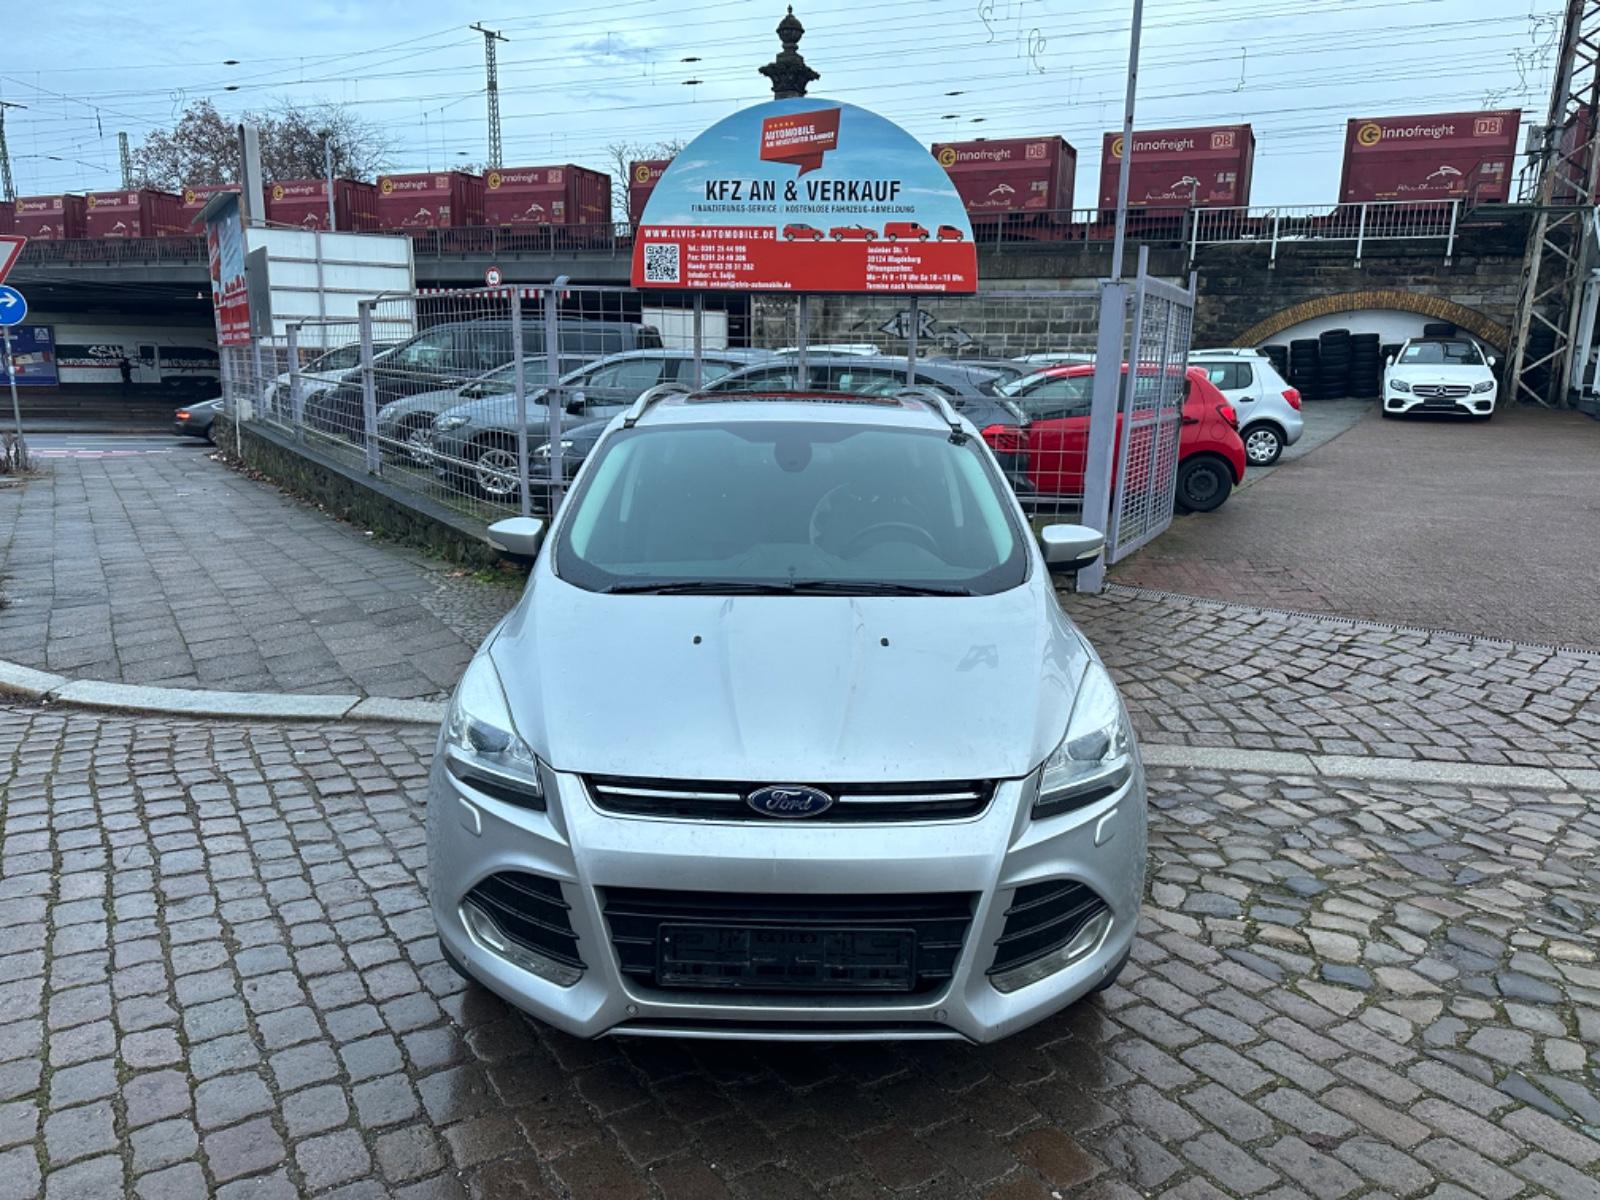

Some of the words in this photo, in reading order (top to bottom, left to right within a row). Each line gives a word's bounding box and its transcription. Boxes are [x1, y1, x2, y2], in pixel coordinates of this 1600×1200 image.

[765, 125, 816, 141] AUTOMOBILE
[1382, 124, 1456, 139] innofreight
[1476, 119, 1499, 134] DB
[1132, 139, 1195, 152] innofreight
[956, 148, 1012, 161] innofreight
[705, 180, 742, 201] KFZ
[749, 180, 776, 201] AN
[784, 180, 798, 201] &
[806, 180, 901, 201] VERKAUF
[691, 204, 777, 213] FINANZIERUNGS-SERVICE
[785, 204, 829, 213] KOSTENLOSE
[831, 205, 915, 214] FAHRZEUG-ABMELDUNG
[644, 228, 775, 240] WWW.ELVIS-AUTOMOBILE.DE
[887, 255, 921, 265] Magdeburg
[766, 789, 813, 810] Ford
